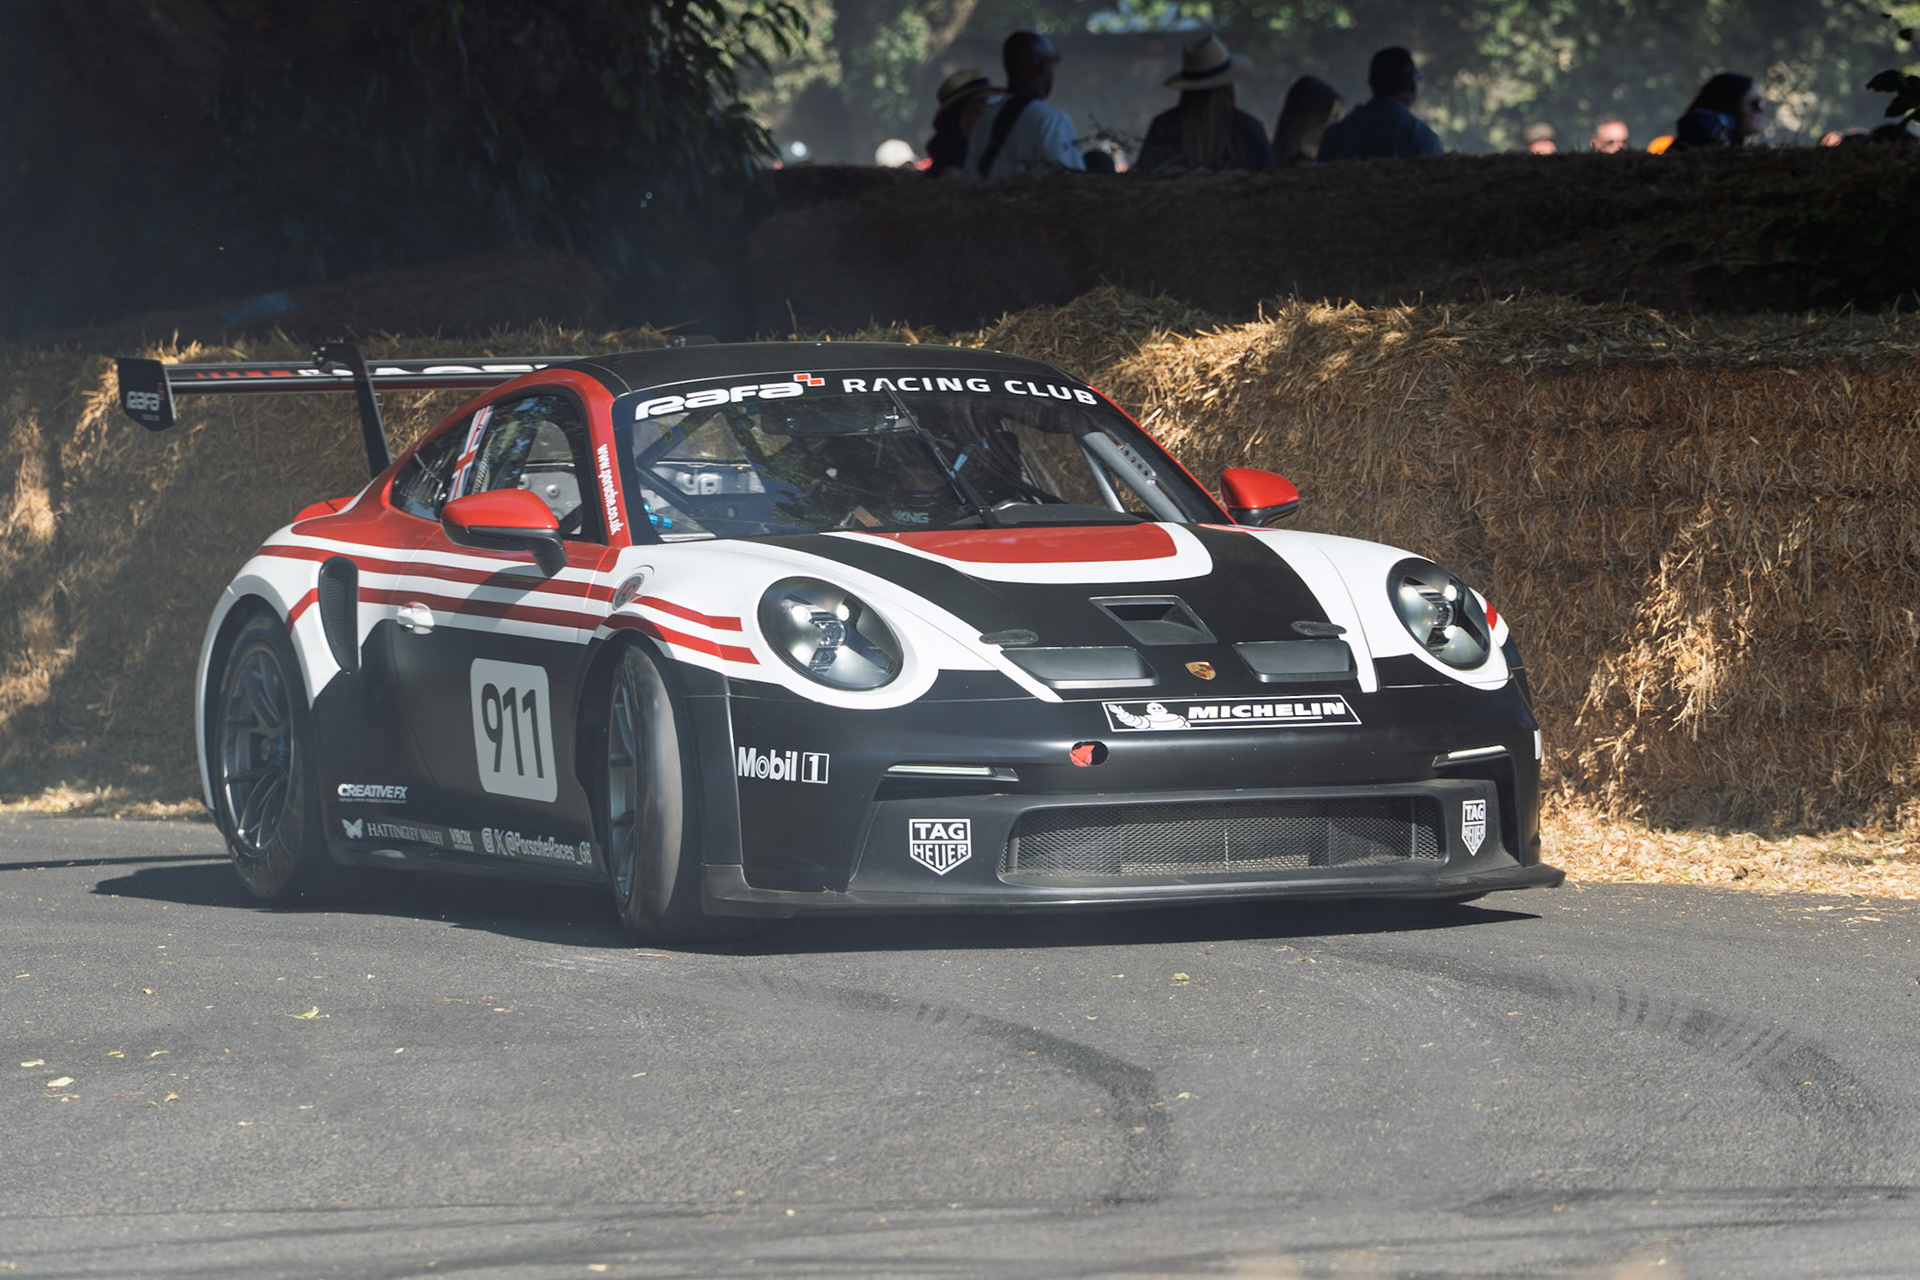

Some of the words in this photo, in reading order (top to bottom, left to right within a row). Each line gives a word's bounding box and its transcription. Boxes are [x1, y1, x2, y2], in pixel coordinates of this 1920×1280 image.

[842, 377, 991, 393] RACING
[1004, 380, 1097, 405] CLUB
[597, 444, 624, 536] www.porsche.co.uk
[1188, 702, 1346, 719] MICHELIN
[481, 683, 544, 779] 911
[738, 746, 798, 781] Mobil
[1465, 804, 1484, 821] TAG
[367, 822, 419, 841] HATTINGLEY
[419, 829, 444, 845] VALLEY
[449, 828, 473, 845] VBOX
[914, 823, 965, 840] TAG
[914, 844, 967, 870] HEUER
